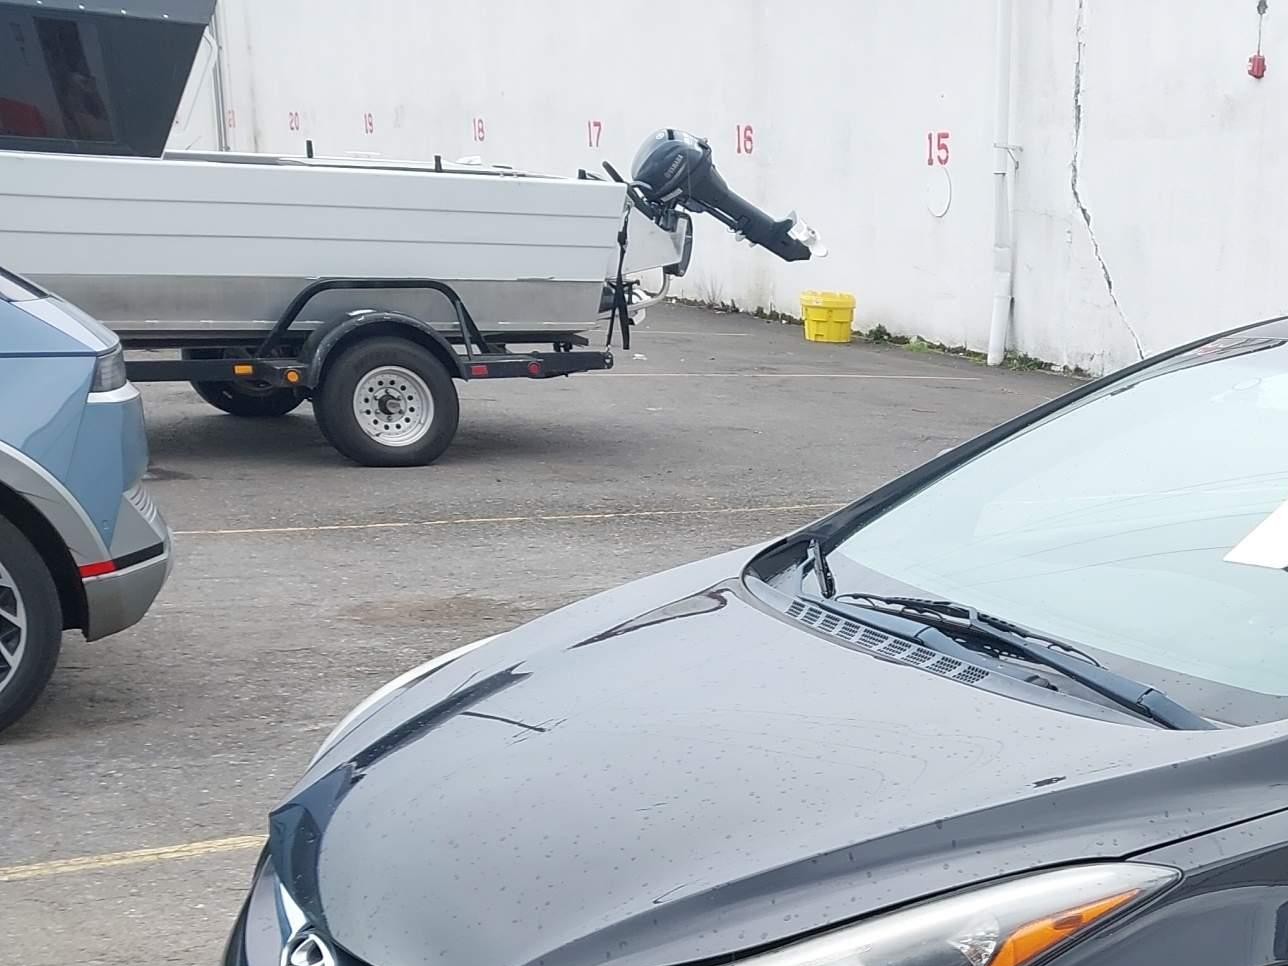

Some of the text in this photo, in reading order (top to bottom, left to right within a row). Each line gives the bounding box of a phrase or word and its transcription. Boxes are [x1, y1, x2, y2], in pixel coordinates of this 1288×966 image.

[288, 111, 300, 131] 20
[364, 112, 374, 134] 19
[473, 117, 485, 142] 18
[587, 121, 602, 148] 17
[736, 125, 754, 154] 16
[927, 132, 950, 166] 15
